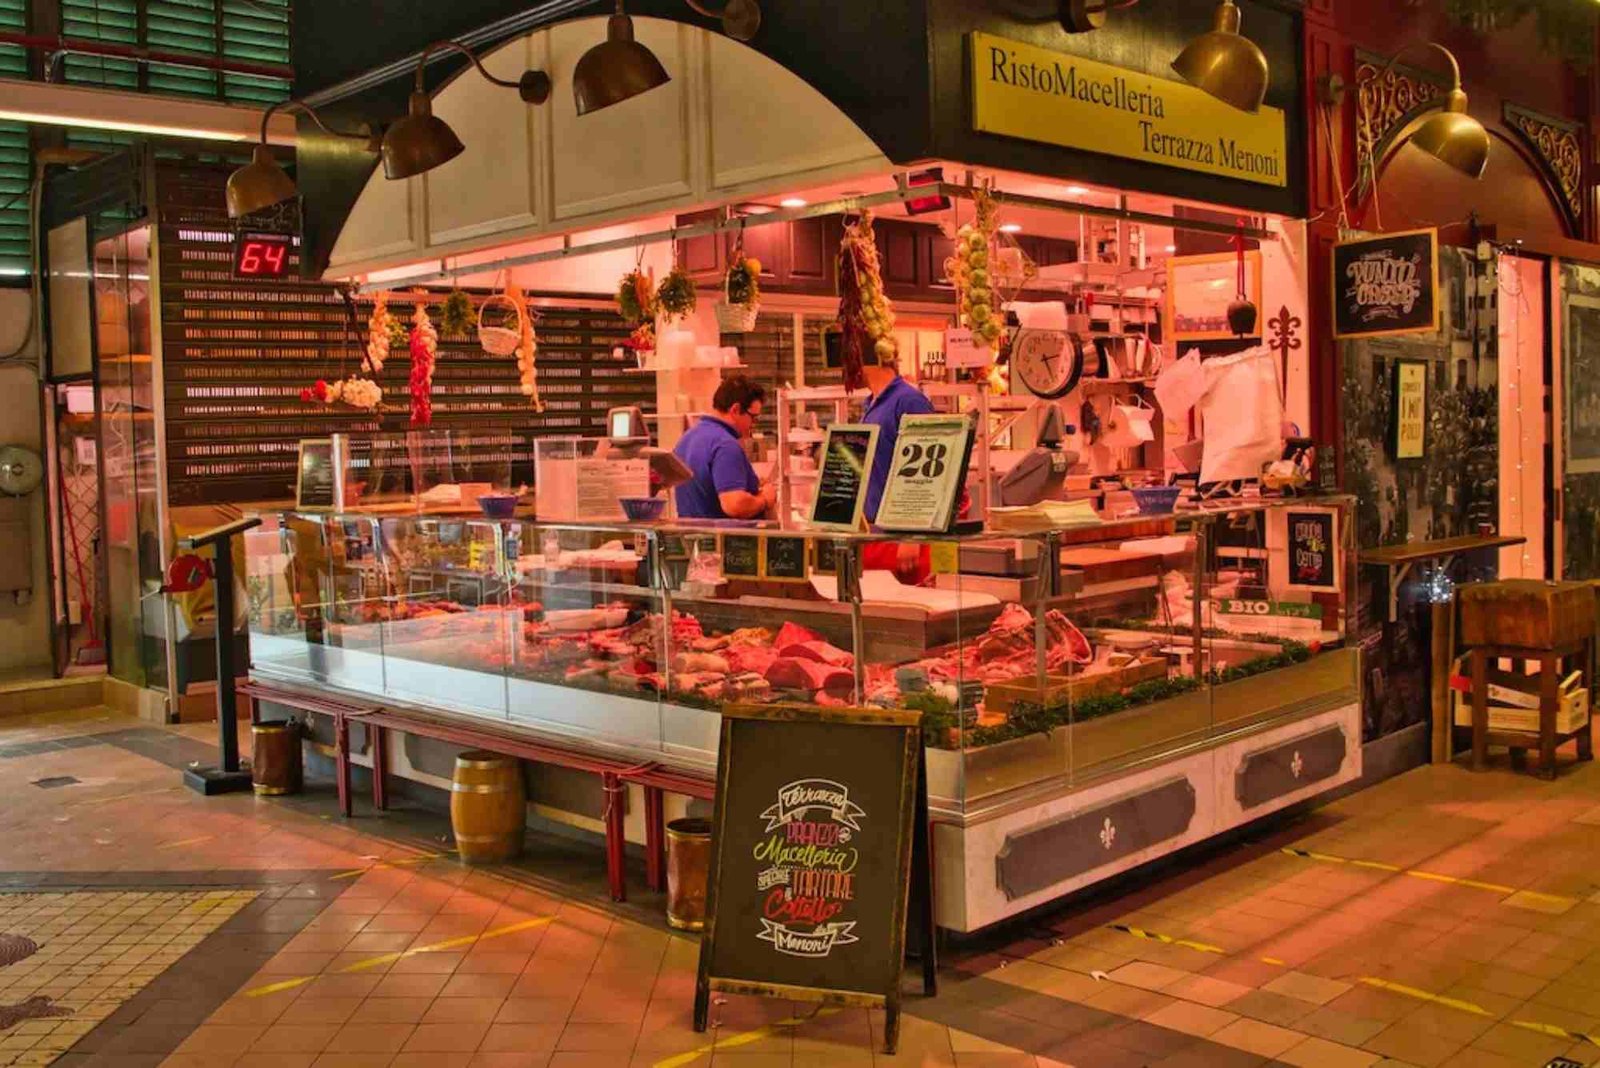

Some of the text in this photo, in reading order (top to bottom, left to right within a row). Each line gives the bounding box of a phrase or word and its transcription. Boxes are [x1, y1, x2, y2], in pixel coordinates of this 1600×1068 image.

[989, 46, 1165, 119] RistoMacelleria
[1138, 120, 1279, 177] Terrazza Menoni
[240, 243, 285, 273] 64
[897, 443, 947, 478] 28
[1228, 599, 1270, 614] BIO
[782, 785, 845, 807] Terrazza
[753, 835, 858, 873] Macelleria
[778, 931, 829, 951] Menoni
